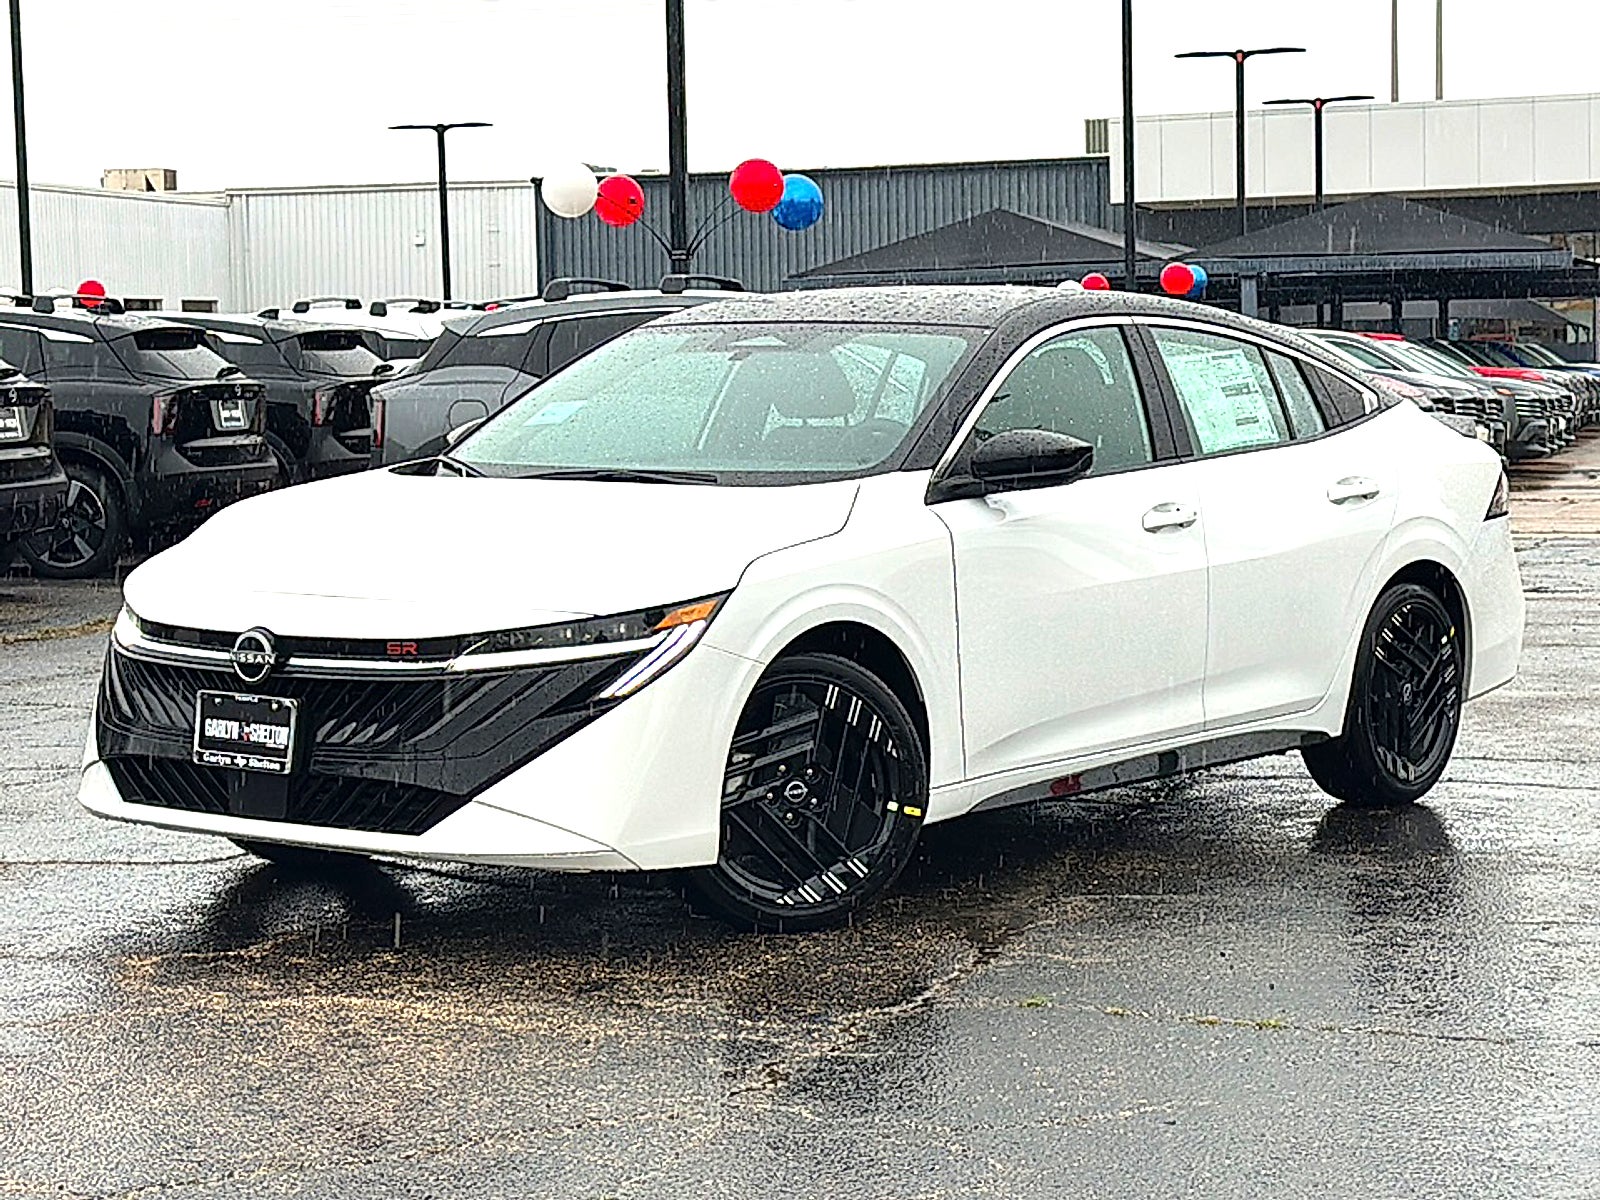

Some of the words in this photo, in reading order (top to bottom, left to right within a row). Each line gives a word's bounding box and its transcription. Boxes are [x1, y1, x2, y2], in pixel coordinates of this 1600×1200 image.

[387, 642, 418, 654] SR
[230, 651, 276, 664] NISSAN
[204, 718, 239, 739] GARLYN
[250, 723, 289, 745] SHELTON
